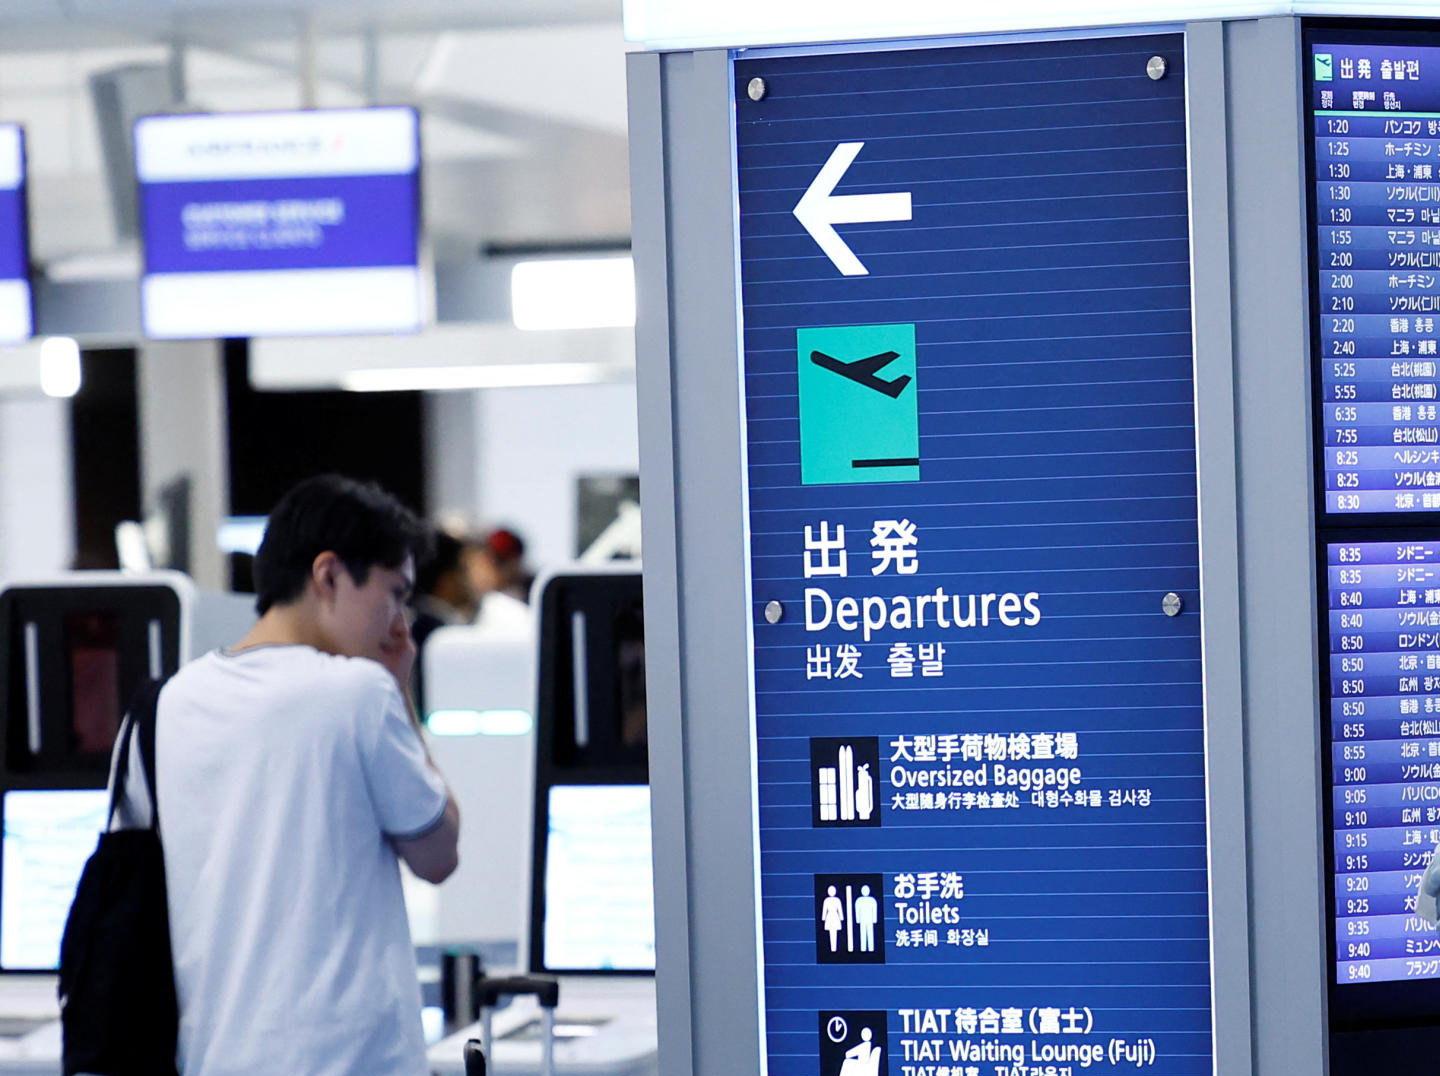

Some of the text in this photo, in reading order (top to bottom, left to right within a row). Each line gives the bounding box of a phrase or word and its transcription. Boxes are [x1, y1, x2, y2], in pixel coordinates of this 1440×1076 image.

[1340, 57, 1371, 79] 出発
[1380, 59, 1419, 80] 출발편
[1328, 119, 1348, 133] 1:20
[1329, 141, 1348, 155] 1:25
[1385, 142, 1431, 156] ホーチミン
[1329, 163, 1349, 178] 1:30
[1330, 185, 1350, 200] 1:30
[1387, 185, 1440, 202] ソウル(仁川)
[1331, 208, 1351, 222] 1:30
[1387, 209, 1414, 223] マニラ
[1332, 230, 1351, 244] 1:55
[1388, 230, 1415, 244] マニラ
[1331, 252, 1352, 266] 2:00
[1332, 274, 1353, 288] 2:00
[1389, 274, 1434, 288] ホーチミン
[1333, 296, 1353, 310] 2:10
[1333, 318, 1354, 332] 2:20
[1390, 318, 1408, 333] 香港
[1334, 340, 1354, 355] 2:40
[1335, 362, 1355, 376] 5:25
[1335, 385, 1356, 399] 5:55
[1336, 406, 1356, 421] 6:35
[1393, 405, 1411, 421] 香港
[1336, 429, 1357, 444] 7:55
[1393, 427, 1438, 443] 台北(松山)
[1337, 450, 1358, 466] 8:25
[1394, 449, 1439, 464] ヘルシンキ
[1337, 472, 1358, 487] 8:25
[1338, 494, 1360, 510] 8:30
[803, 518, 919, 578] 出発
[1340, 547, 1360, 562] 8:35
[1397, 545, 1433, 560] シドニー
[1340, 569, 1361, 584] 8:35
[1398, 567, 1433, 582] シドニー
[1341, 592, 1362, 606] 8:40
[804, 586, 1042, 642] Departures
[1341, 613, 1362, 628] 8:40
[1342, 635, 1362, 650] 8:50
[806, 642, 946, 680] 出发 출발
[1343, 657, 1363, 672] 8:50
[1343, 679, 1364, 694] 8:50
[1343, 699, 1418, 716] 8:50 香港
[1344, 723, 1364, 738] 8:55
[890, 732, 1079, 763] 大型手荷物検査場
[1344, 745, 1365, 760] 8:55
[890, 763, 1082, 792] Oversized Baggage
[1345, 767, 1365, 782] 9:00
[1031, 790, 1103, 808] 대형수화물
[1108, 788, 1152, 808] 검사장
[1345, 789, 1366, 803] 9:05
[1346, 811, 1366, 825] 9:10
[1346, 833, 1367, 847] 9:15
[1347, 855, 1367, 869] 9:15
[893, 872, 964, 900] お手洗
[1347, 877, 1368, 891] 9:20
[1348, 898, 1368, 913] 9:25
[895, 902, 960, 925] Toilets
[1348, 920, 1369, 935] 9:35
[895, 928, 990, 948] 洗手间 화장실
[1349, 942, 1370, 957] 9:40
[1349, 964, 1370, 979] 9:40
[900, 1038, 1156, 1068] TIAT Waiting Lounge (Fuji)
